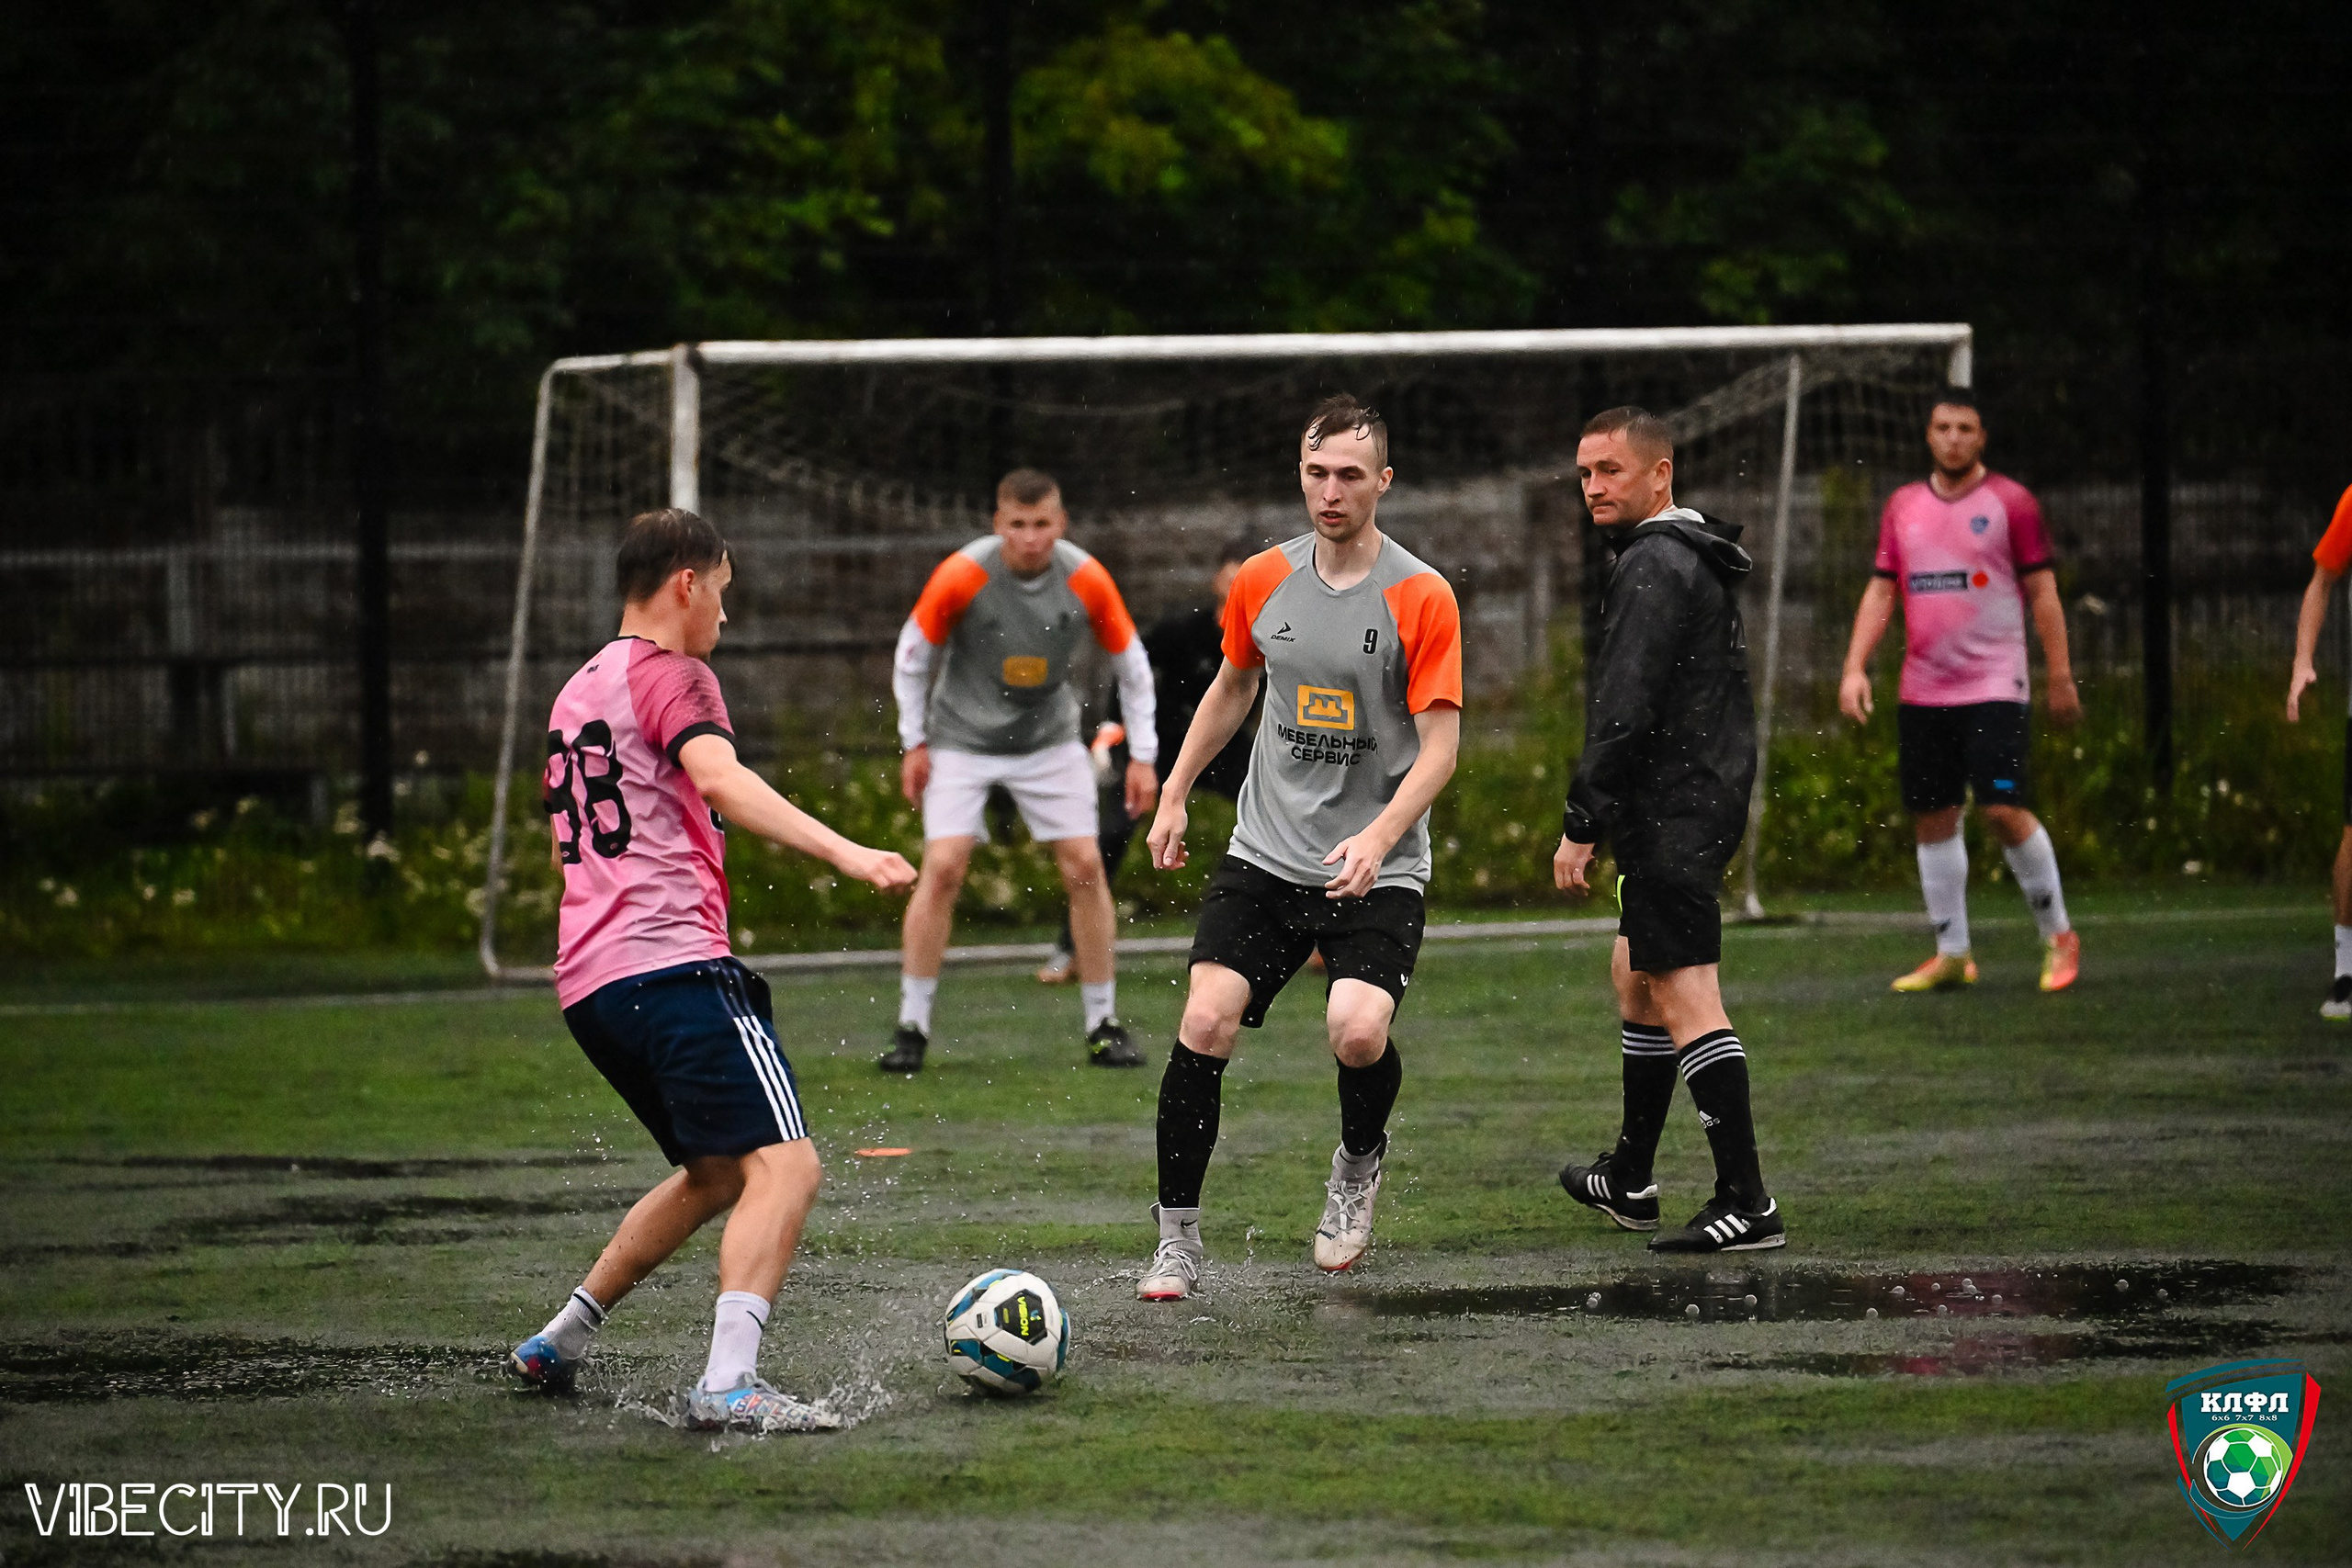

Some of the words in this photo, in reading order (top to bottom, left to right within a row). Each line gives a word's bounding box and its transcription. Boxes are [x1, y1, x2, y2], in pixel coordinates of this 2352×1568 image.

[1270, 634, 1296, 643] DEMIX
[1363, 628, 1379, 655] 9
[1277, 723, 1378, 755] МЕБЕЛЬНЫЙ
[1291, 746, 1362, 767] СЕРВИС
[544, 719, 632, 864] 98
[1016, 1296, 1030, 1337] VISION
